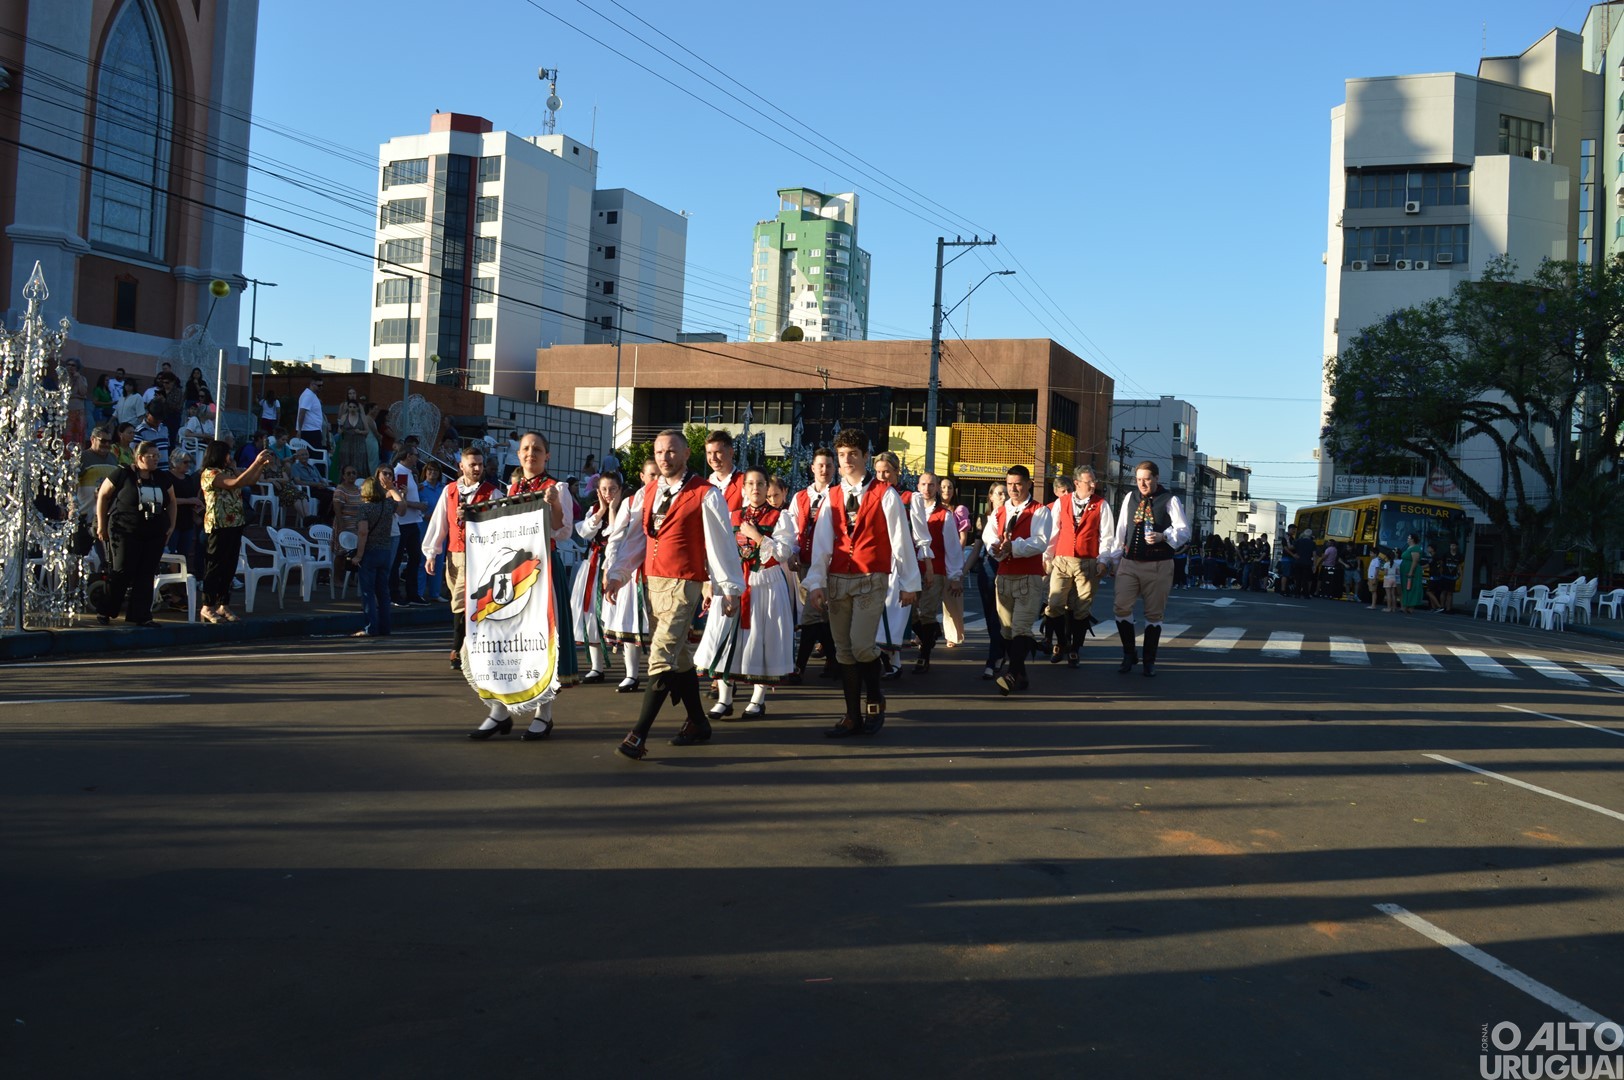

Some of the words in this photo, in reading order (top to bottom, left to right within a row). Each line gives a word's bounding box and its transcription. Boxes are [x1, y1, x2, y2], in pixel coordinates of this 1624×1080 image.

[970, 465, 993, 473] BANCO
[1400, 504, 1450, 518] ESCOLAR
[492, 671, 518, 682] Largo
[526, 669, 541, 680] RS
